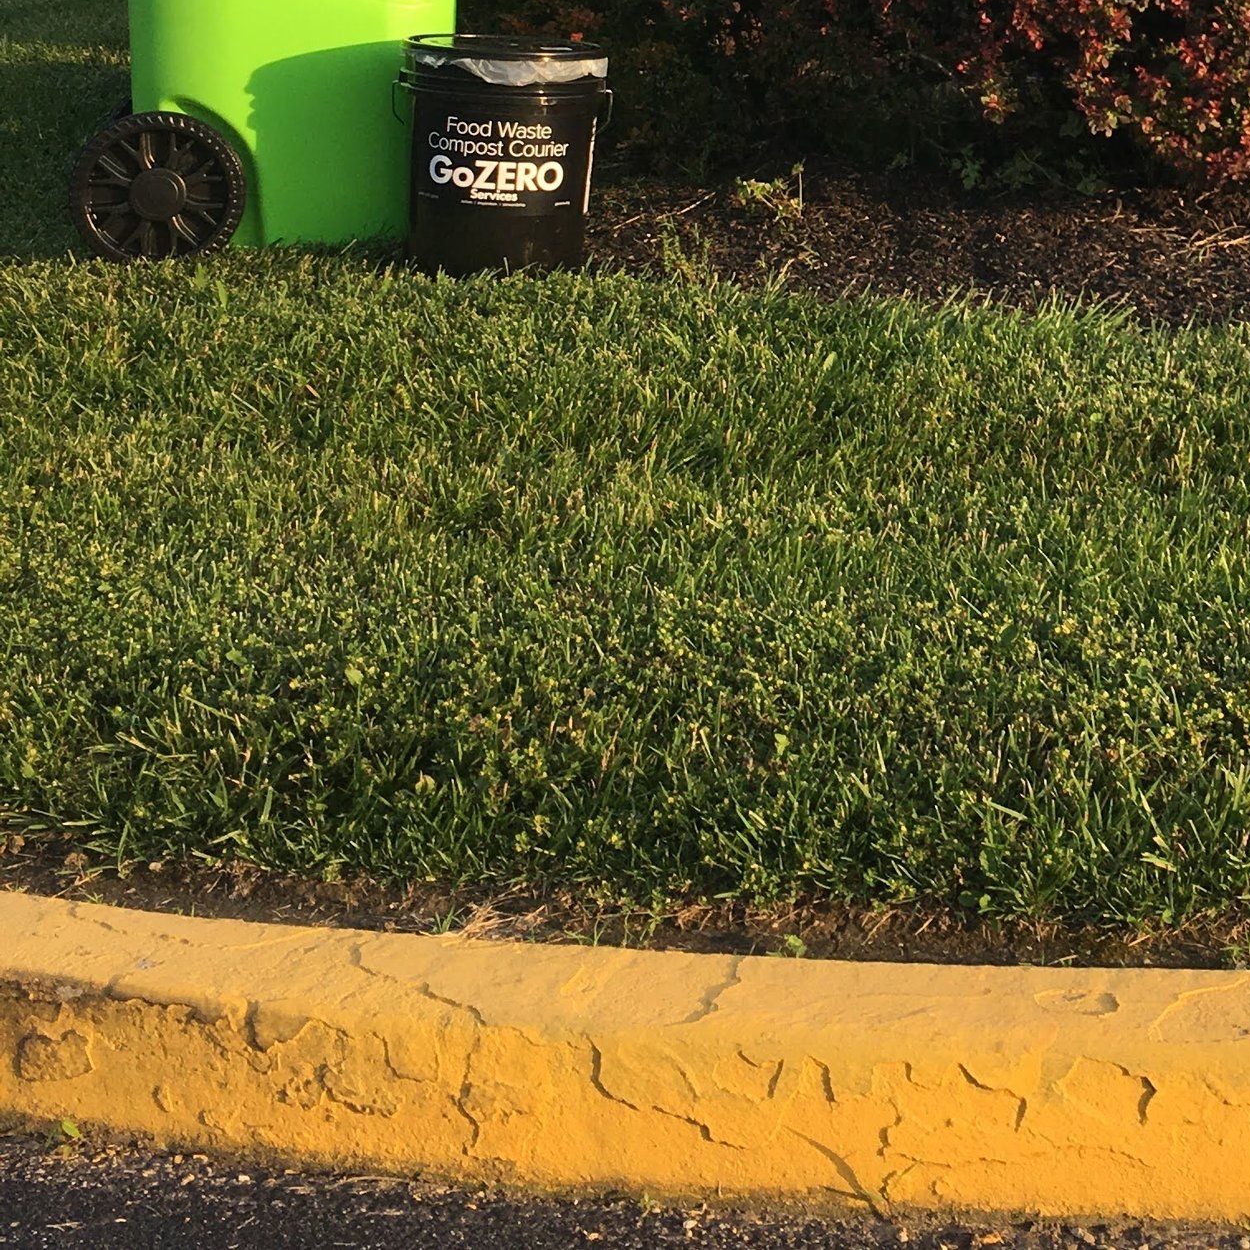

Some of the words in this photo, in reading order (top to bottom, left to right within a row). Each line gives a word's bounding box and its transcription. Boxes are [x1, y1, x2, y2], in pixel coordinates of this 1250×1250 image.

[446, 116, 492, 138] Food
[497, 121, 552, 140] Waste
[428, 131, 504, 157] Compost
[508, 140, 570, 158] Courier
[429, 154, 565, 192] GoZERO
[469, 188, 519, 202] Services
